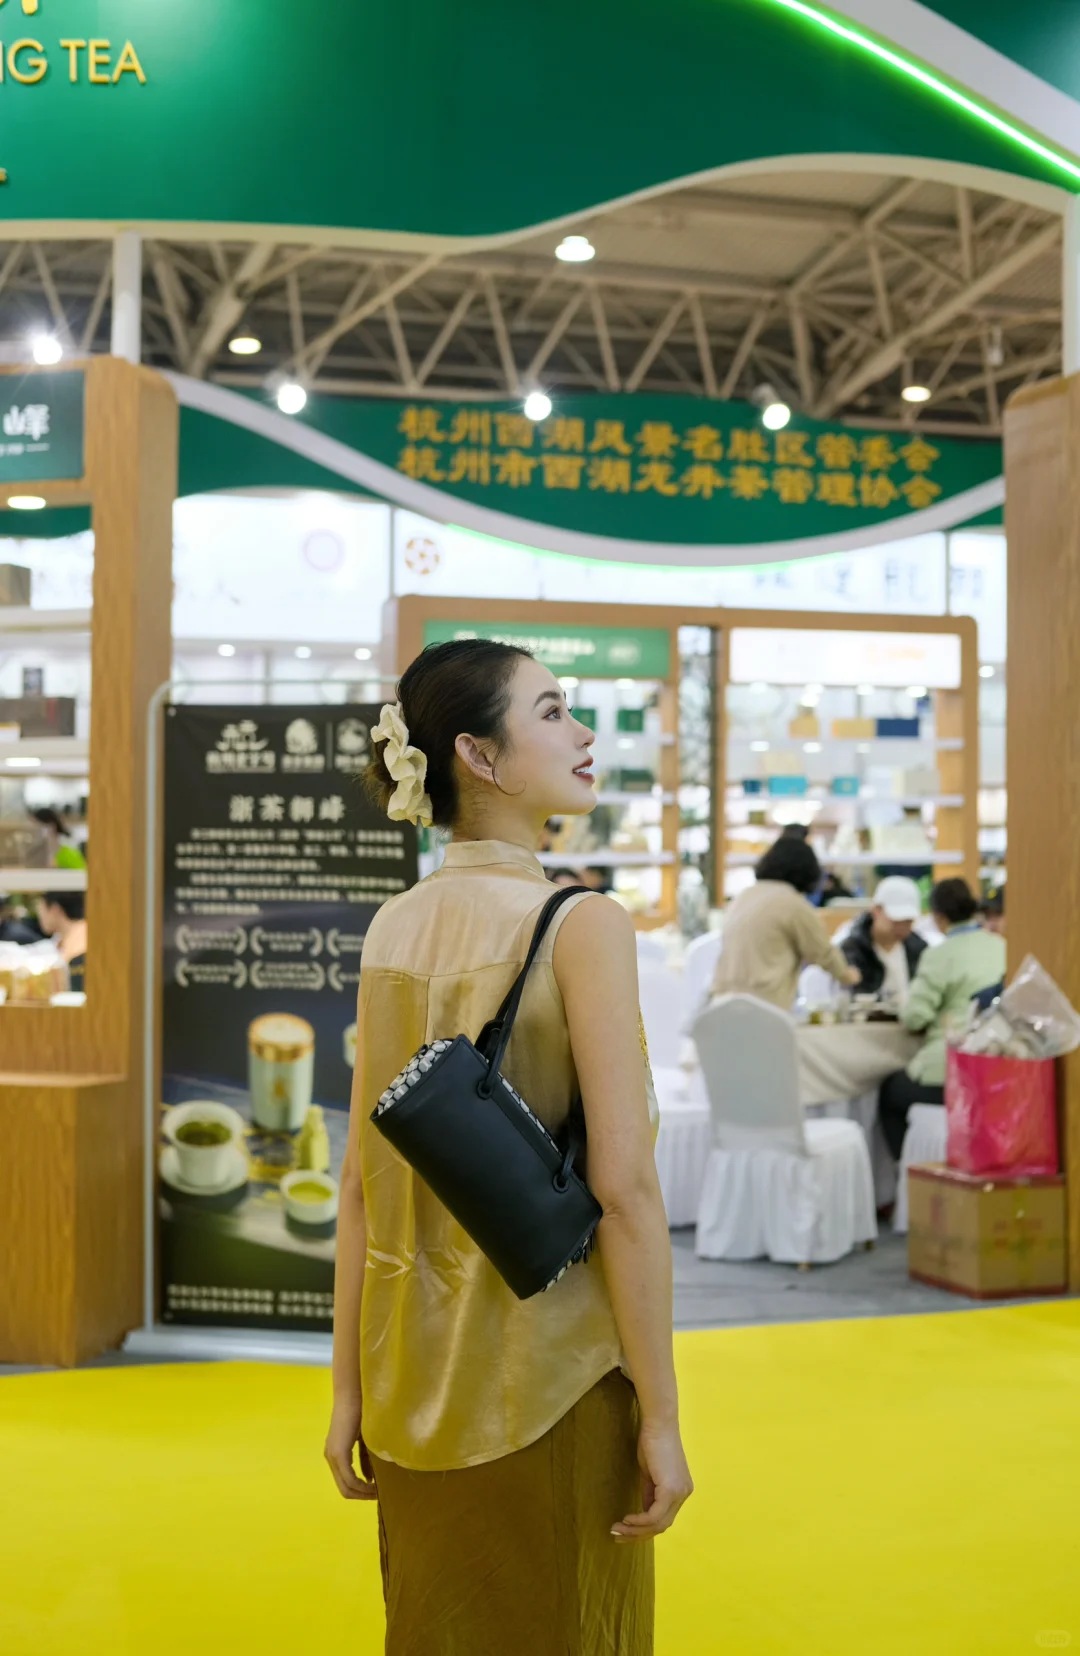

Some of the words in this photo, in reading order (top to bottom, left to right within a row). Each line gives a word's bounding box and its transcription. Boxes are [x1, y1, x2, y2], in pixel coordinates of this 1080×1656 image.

[0, 38, 48, 85] G
[60, 38, 147, 85] TEA
[399, 404, 940, 473] 杭州西湖风景名胜区管委会
[398, 444, 942, 509] 杭州市西湖龙井茶管理协会
